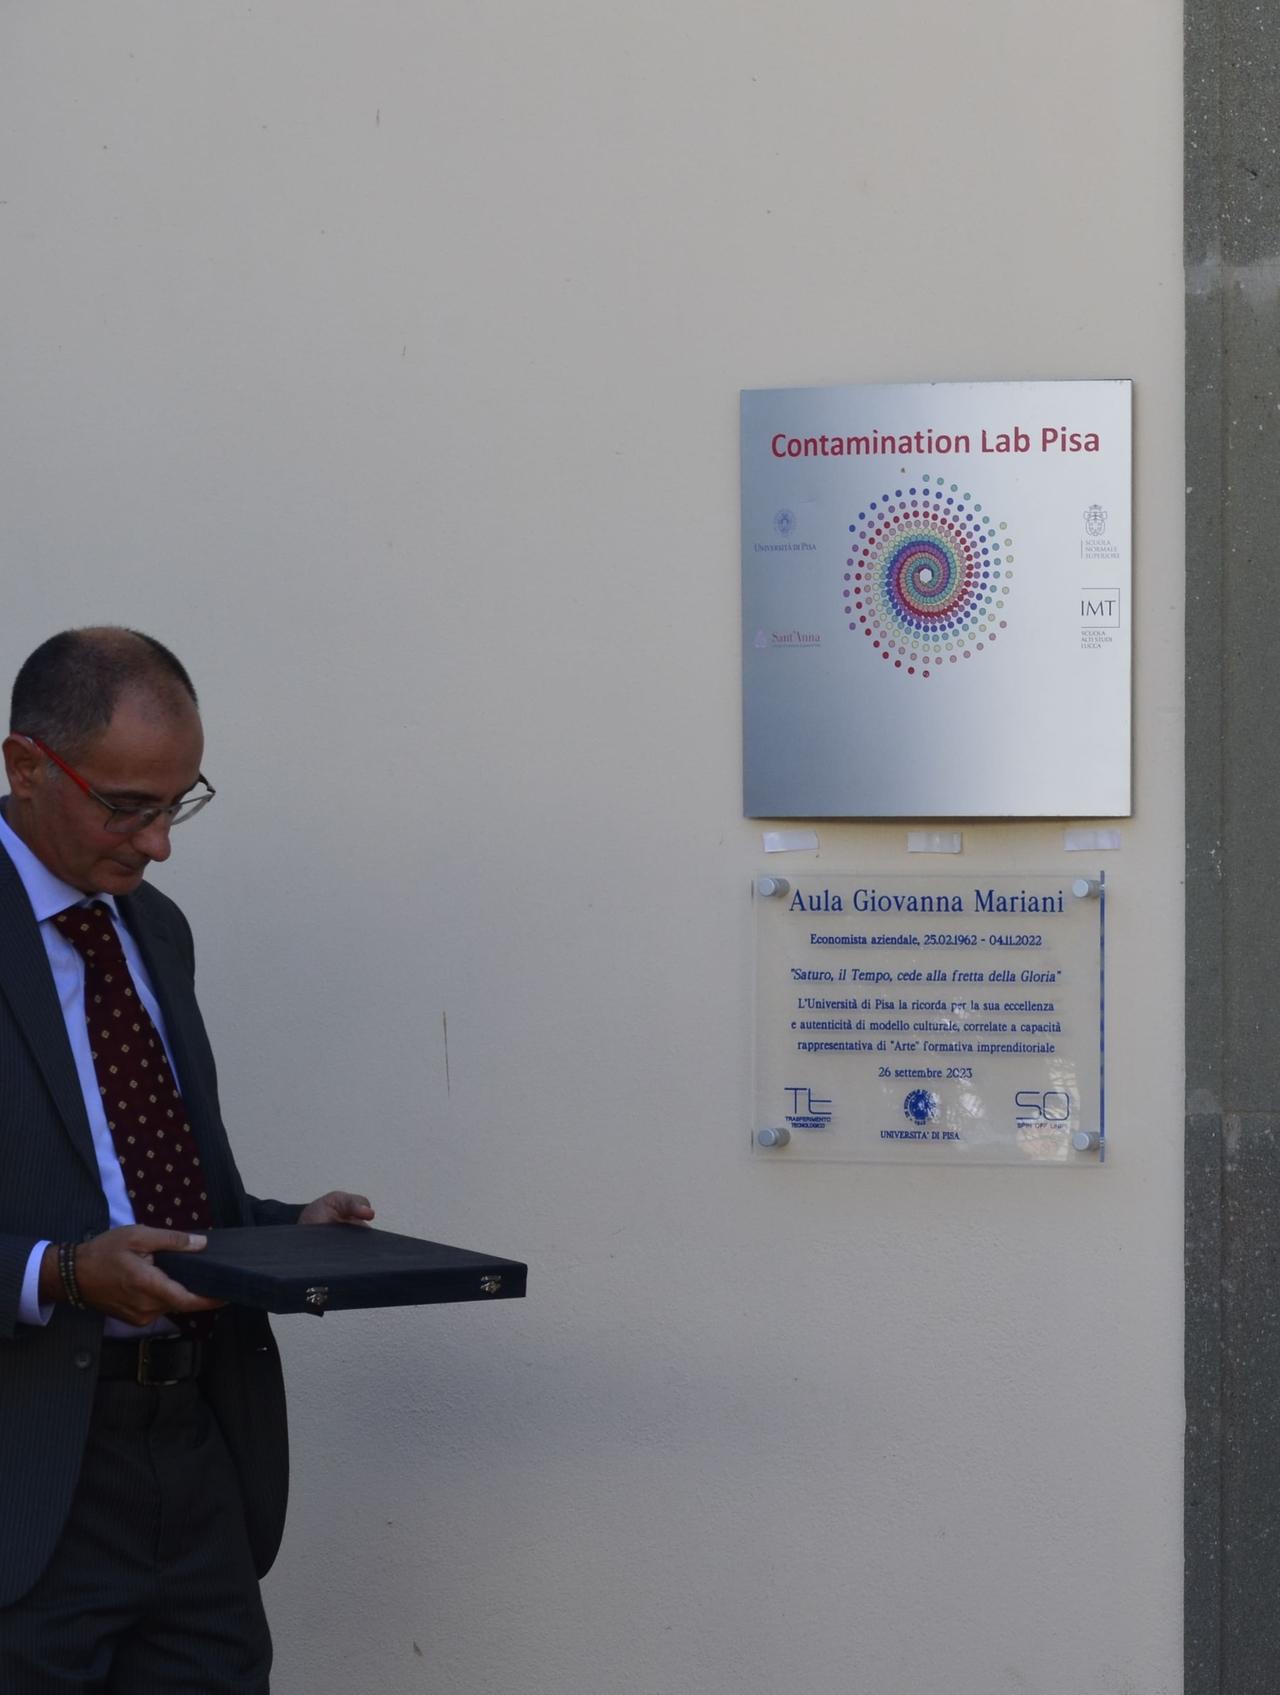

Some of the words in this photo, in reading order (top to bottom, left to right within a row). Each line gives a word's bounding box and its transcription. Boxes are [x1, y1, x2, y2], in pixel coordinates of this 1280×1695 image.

[771, 429, 970, 457] Contamination
[981, 426, 1030, 453] Lab
[1041, 426, 1100, 452] Pisa
[1081, 599, 1116, 616] IMT
[789, 889, 843, 912] Aula
[854, 889, 963, 912] Giovanna
[974, 889, 1065, 913] Mariani
[810, 934, 867, 945] Economista
[871, 934, 920, 946] aziendale,
[924, 934, 977, 946] 25.02.1962
[989, 935, 1042, 946] 04.11.2022
[790, 968, 834, 982] "Saturo,
[838, 969, 847, 981] il
[852, 969, 893, 983] Tempo,
[897, 969, 922, 981] cede
[926, 970, 947, 981] alla
[952, 970, 984, 982] fretta
[988, 970, 1016, 982] della
[1021, 970, 1062, 983] Gloria"
[798, 999, 857, 1009] L'Università
[861, 1000, 871, 1009] di
[875, 1000, 894, 1010] Pisa
[899, 999, 907, 1009] la
[911, 1000, 947, 1010] ricorda
[951, 1002, 967, 1012] per
[971, 1000, 979, 1010] la
[1004, 1001, 1054, 1011] eccellenza
[800, 1019, 852, 1030] autenticità
[856, 1020, 865, 1030] di
[870, 1020, 909, 1031] modello
[913, 1020, 960, 1032] culturale,
[964, 1022, 1007, 1032] correlate
[1010, 1024, 1017, 1032] a
[1020, 1022, 1061, 1034] capacità
[797, 1040, 873, 1052] rappresentativa
[877, 1041, 886, 1050] di
[890, 1041, 919, 1051] "Arte"
[923, 1041, 973, 1051] formativa
[977, 1041, 1055, 1054] imprenditoriale
[878, 1067, 891, 1077] 26
[895, 1068, 942, 1078] settembre
[946, 1068, 973, 1079] 2023
[932, 1132, 939, 1140] DI
[943, 1132, 960, 1140] PISA
